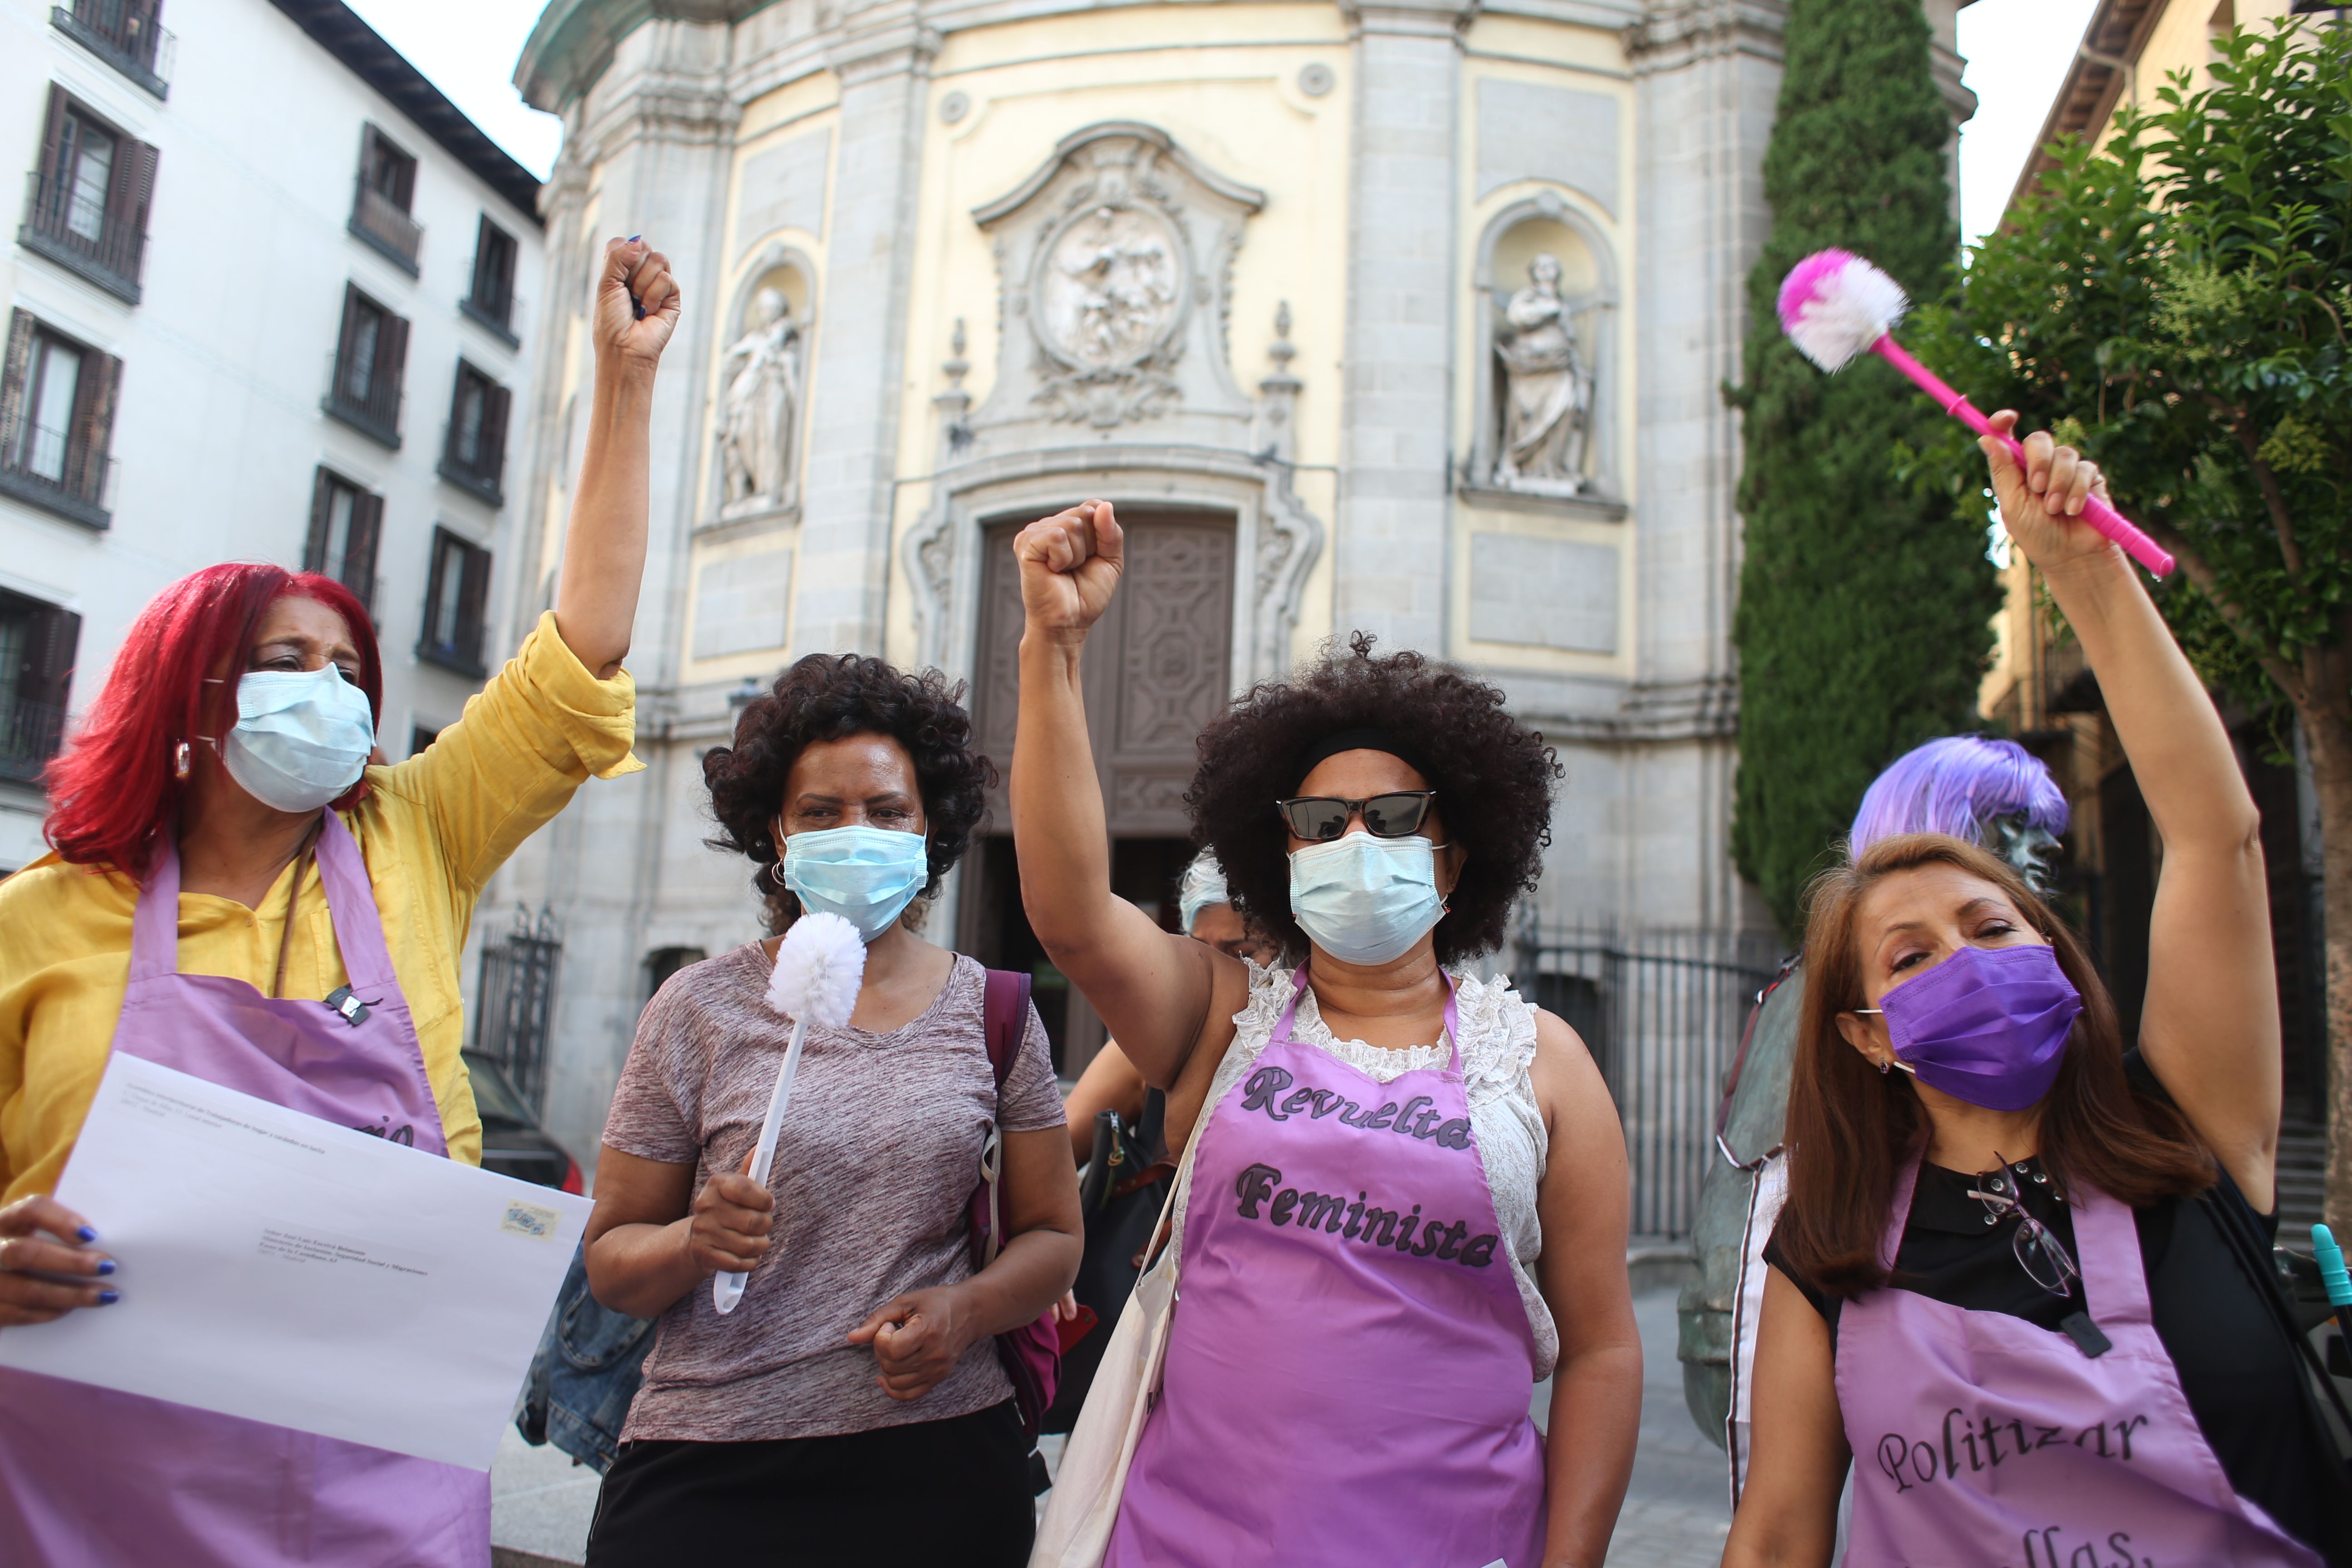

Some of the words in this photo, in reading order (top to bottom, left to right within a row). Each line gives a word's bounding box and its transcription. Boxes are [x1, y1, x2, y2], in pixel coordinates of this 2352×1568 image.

[1240, 1066, 1471, 1150] Revuelta
[1236, 1163, 1499, 1267] Feminista
[1877, 1407, 2149, 1494] Politizar
